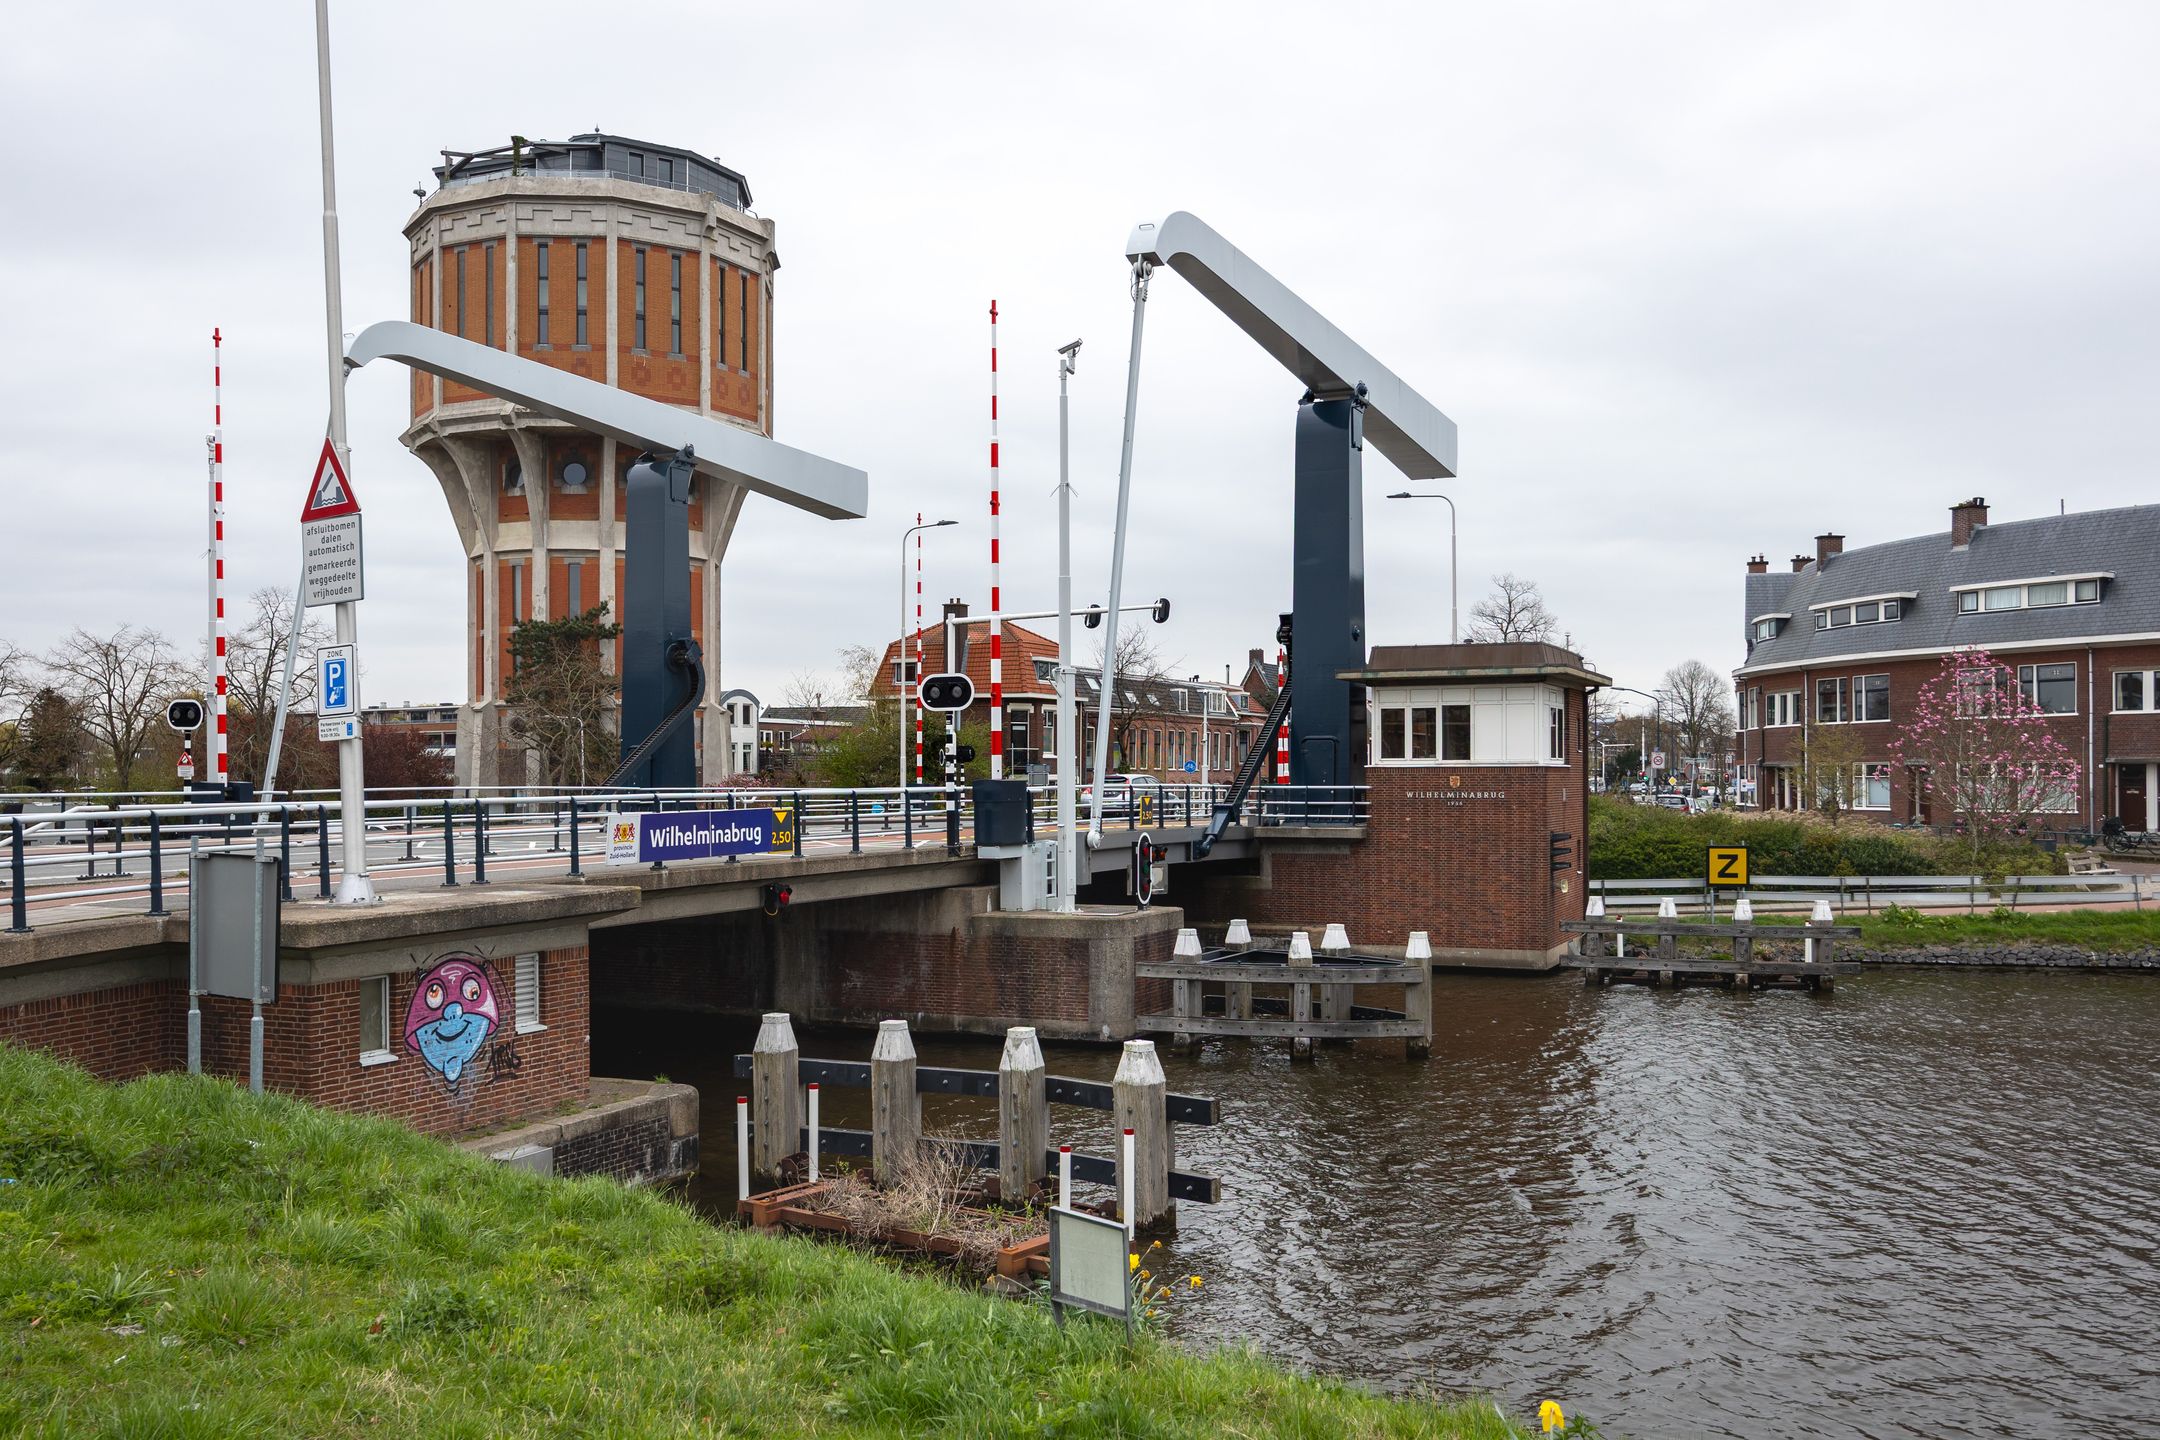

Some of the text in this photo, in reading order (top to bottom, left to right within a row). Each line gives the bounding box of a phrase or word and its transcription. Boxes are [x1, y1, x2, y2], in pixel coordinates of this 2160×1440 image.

[306, 521, 356, 536] afsluitbomen
[320, 534, 341, 544] dalen
[308, 541, 354, 556] automatisch
[308, 558, 356, 574] gemarkeerde
[309, 572, 356, 586] weggedeelte
[313, 586, 352, 599] vrijhouden
[327, 649, 343, 658] ZONE
[329, 663, 341, 688] P
[650, 822, 762, 848] Wilhelminabrug
[771, 831, 791, 846] 2,50
[1717, 854, 1739, 878] Z
